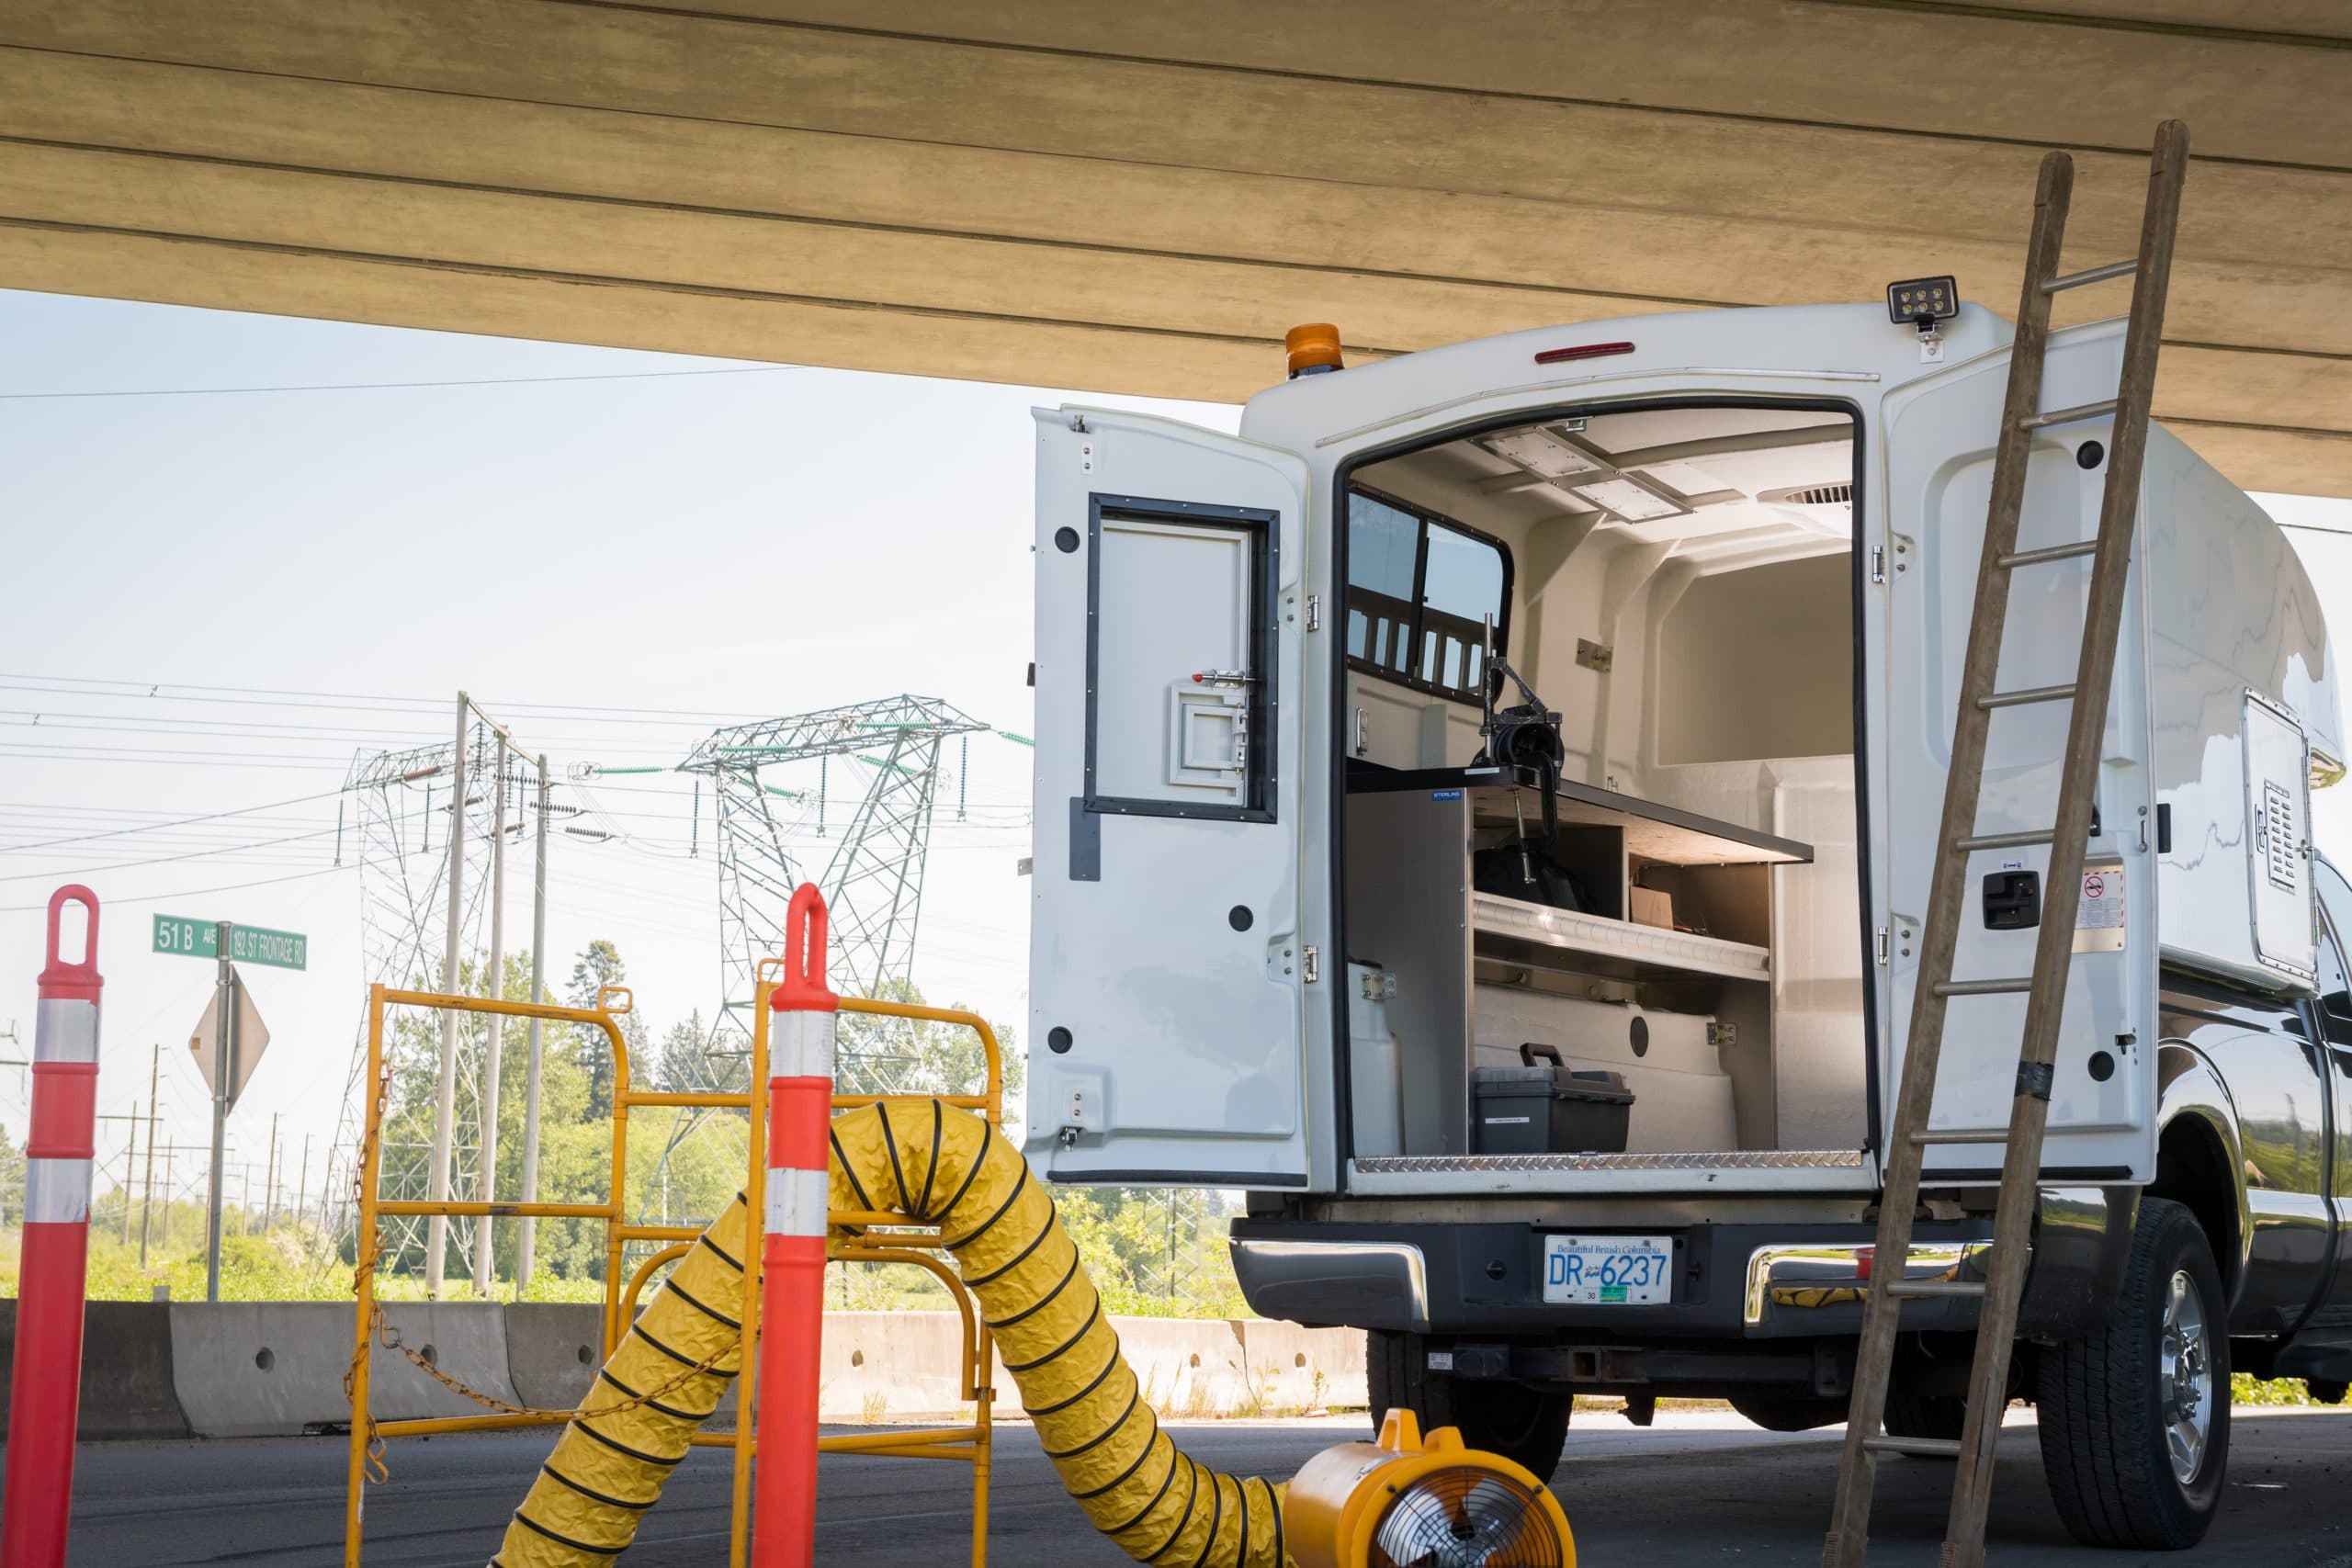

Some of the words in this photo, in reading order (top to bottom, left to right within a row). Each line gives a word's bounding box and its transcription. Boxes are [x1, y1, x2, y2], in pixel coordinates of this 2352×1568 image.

[159, 921, 179, 948] 51
[184, 924, 193, 950] B
[203, 928, 217, 944] AVE
[234, 930, 246, 956] 192
[247, 931, 257, 958] ST
[259, 934, 293, 963] FRONTAGE
[294, 940, 304, 964] RD
[1557, 1245, 1593, 1254] Beautiful
[1596, 1245, 1621, 1254] British
[1623, 1246, 1660, 1255] Columbia
[1549, 1254, 1583, 1285] DR
[1600, 1255, 1667, 1286] 6237
[1587, 1292, 1596, 1300] 30
